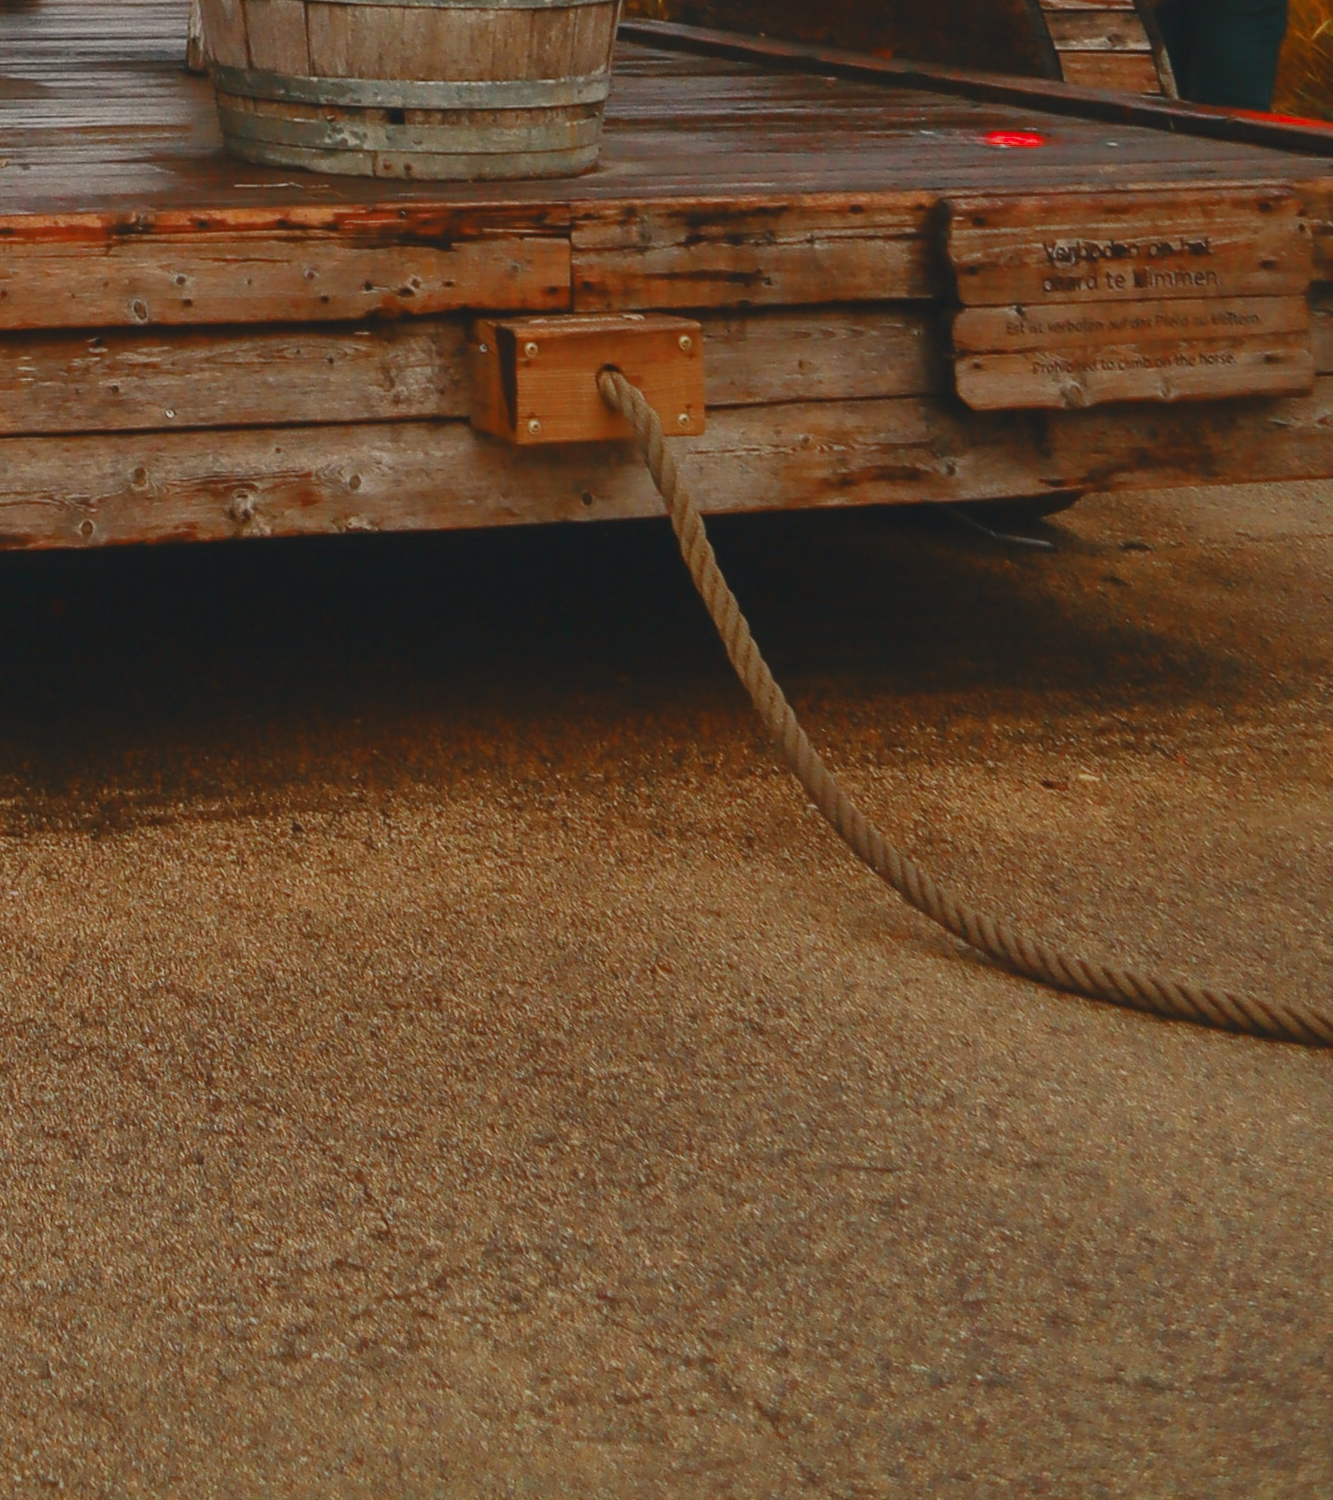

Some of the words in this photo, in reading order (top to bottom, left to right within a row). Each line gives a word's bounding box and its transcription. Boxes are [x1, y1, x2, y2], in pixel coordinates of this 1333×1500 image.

[1043, 274, 1098, 293] prd
[1106, 270, 1127, 289] te
[1100, 358, 1115, 371] to
[1174, 353, 1196, 366] the
